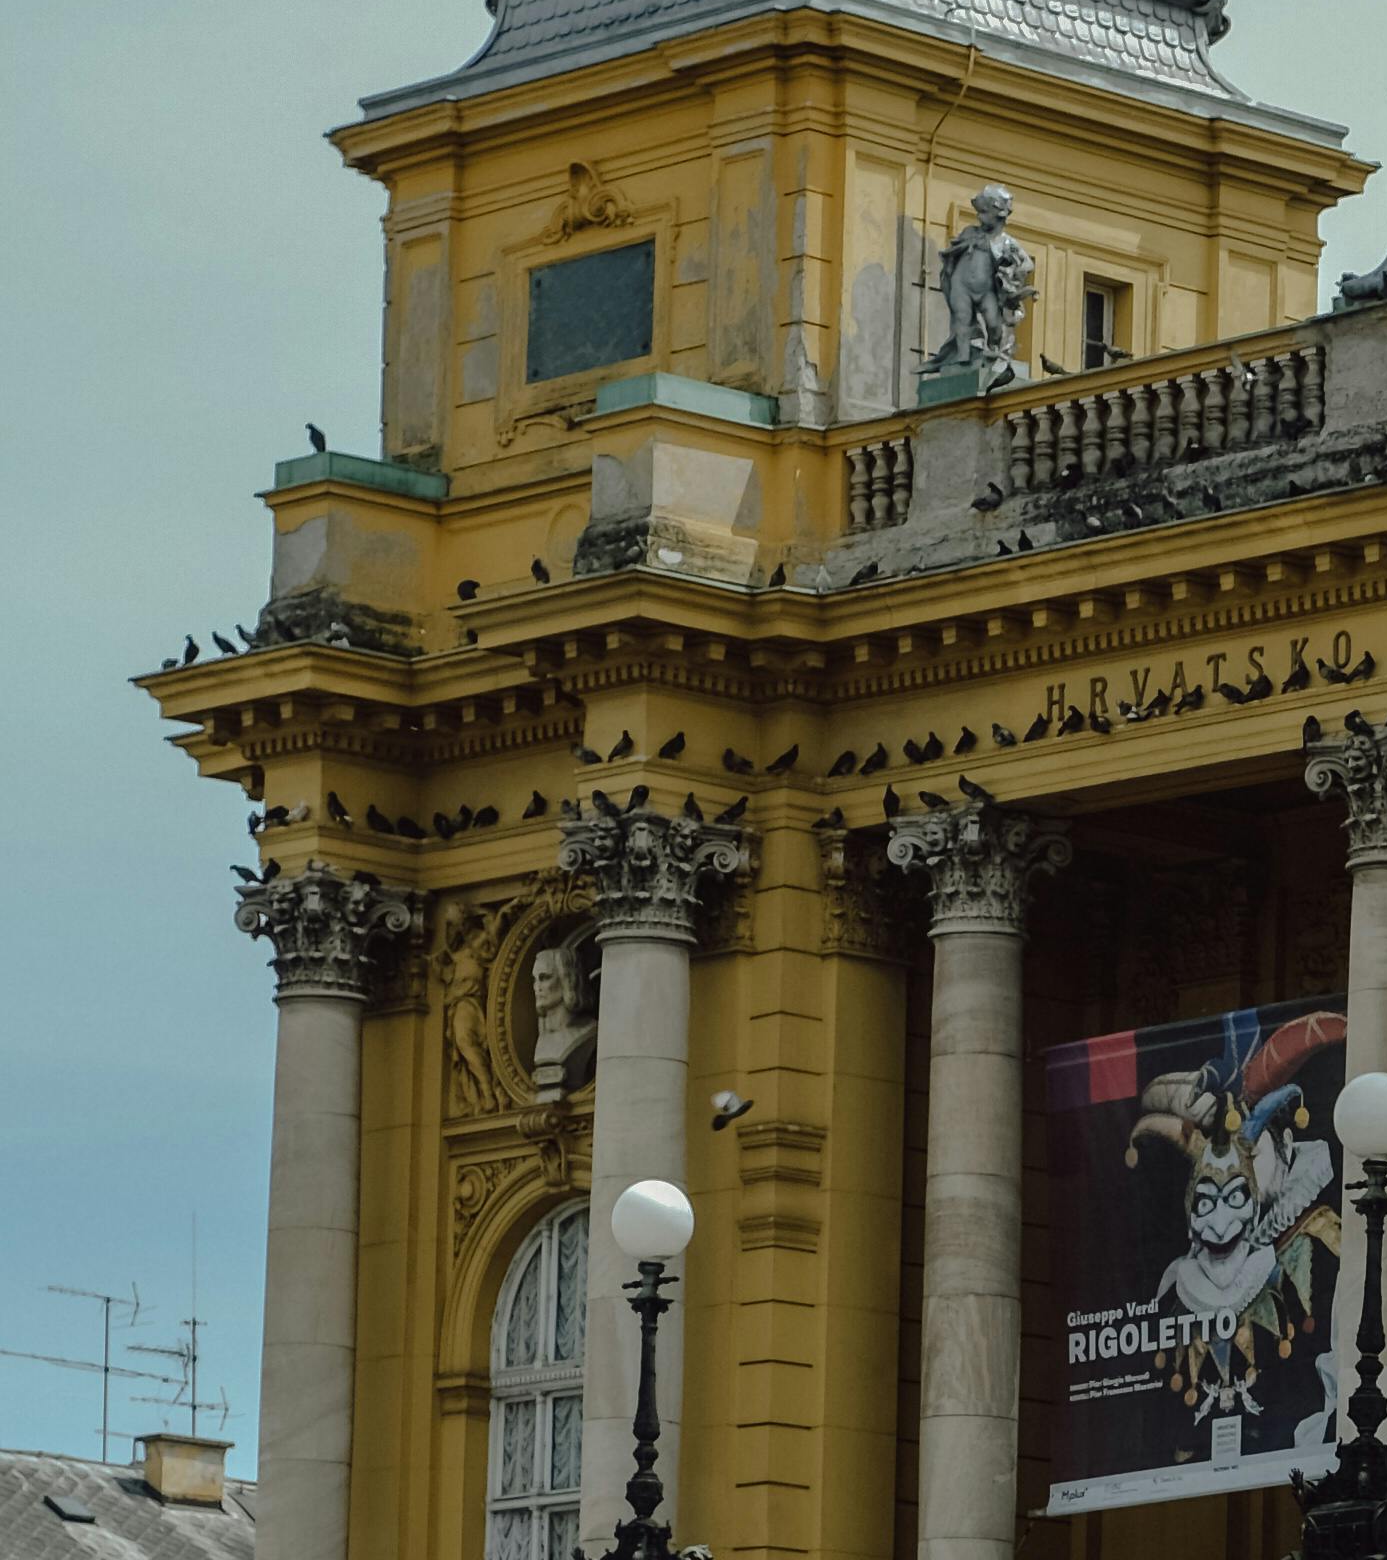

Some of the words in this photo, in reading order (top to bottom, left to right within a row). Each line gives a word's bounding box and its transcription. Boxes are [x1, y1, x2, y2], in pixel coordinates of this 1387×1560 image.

[1046, 630, 1352, 723] HRVATSKO
[1067, 1309, 1124, 1327] Giuseppe
[1125, 1298, 1159, 1318] Verdi
[1068, 1307, 1237, 1365] RIGOLETTO
